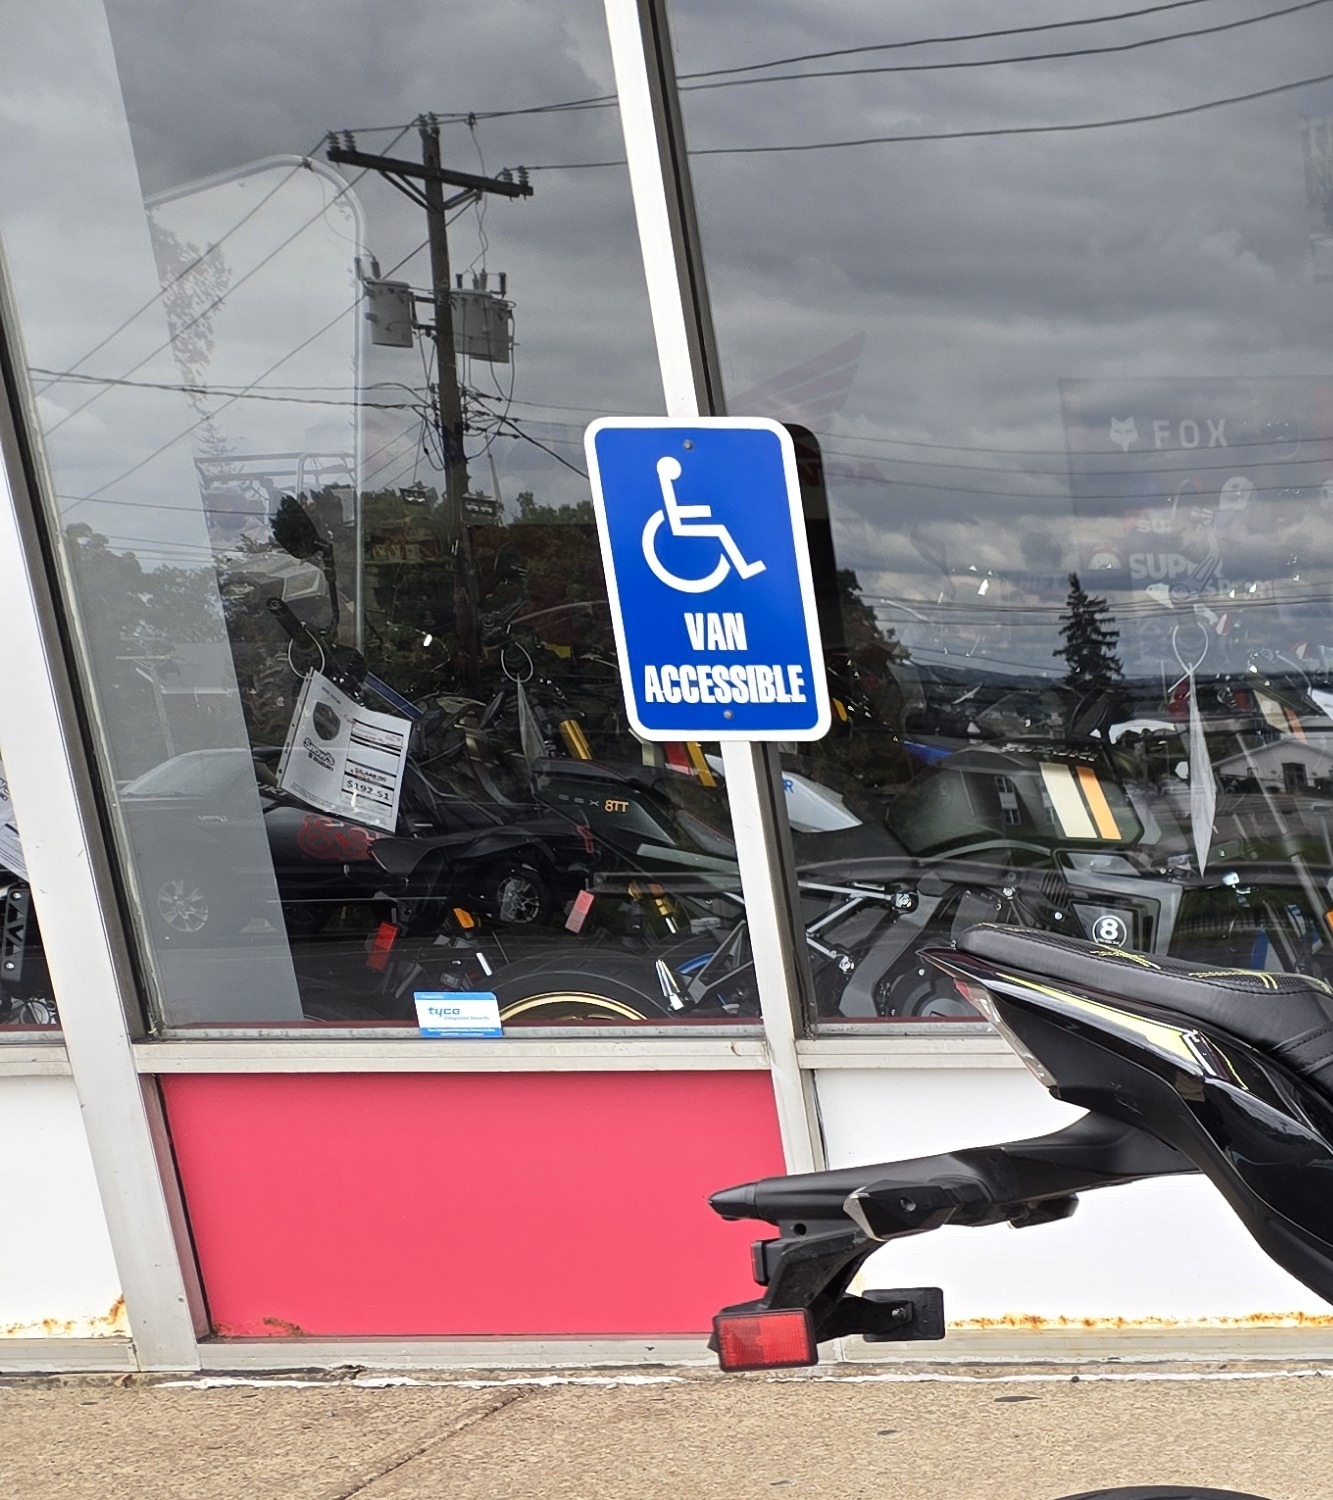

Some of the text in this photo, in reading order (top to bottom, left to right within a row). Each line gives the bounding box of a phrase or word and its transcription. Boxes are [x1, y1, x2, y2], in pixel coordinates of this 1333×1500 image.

[1152, 418, 1229, 449] FOX
[683, 612, 748, 651] VAN
[643, 664, 807, 704] ACCESSIBLE
[347, 780, 390, 801] $192.51
[604, 799, 629, 814] 8TT
[1099, 917, 1119, 940] 8
[428, 1006, 460, 1017] tyco
